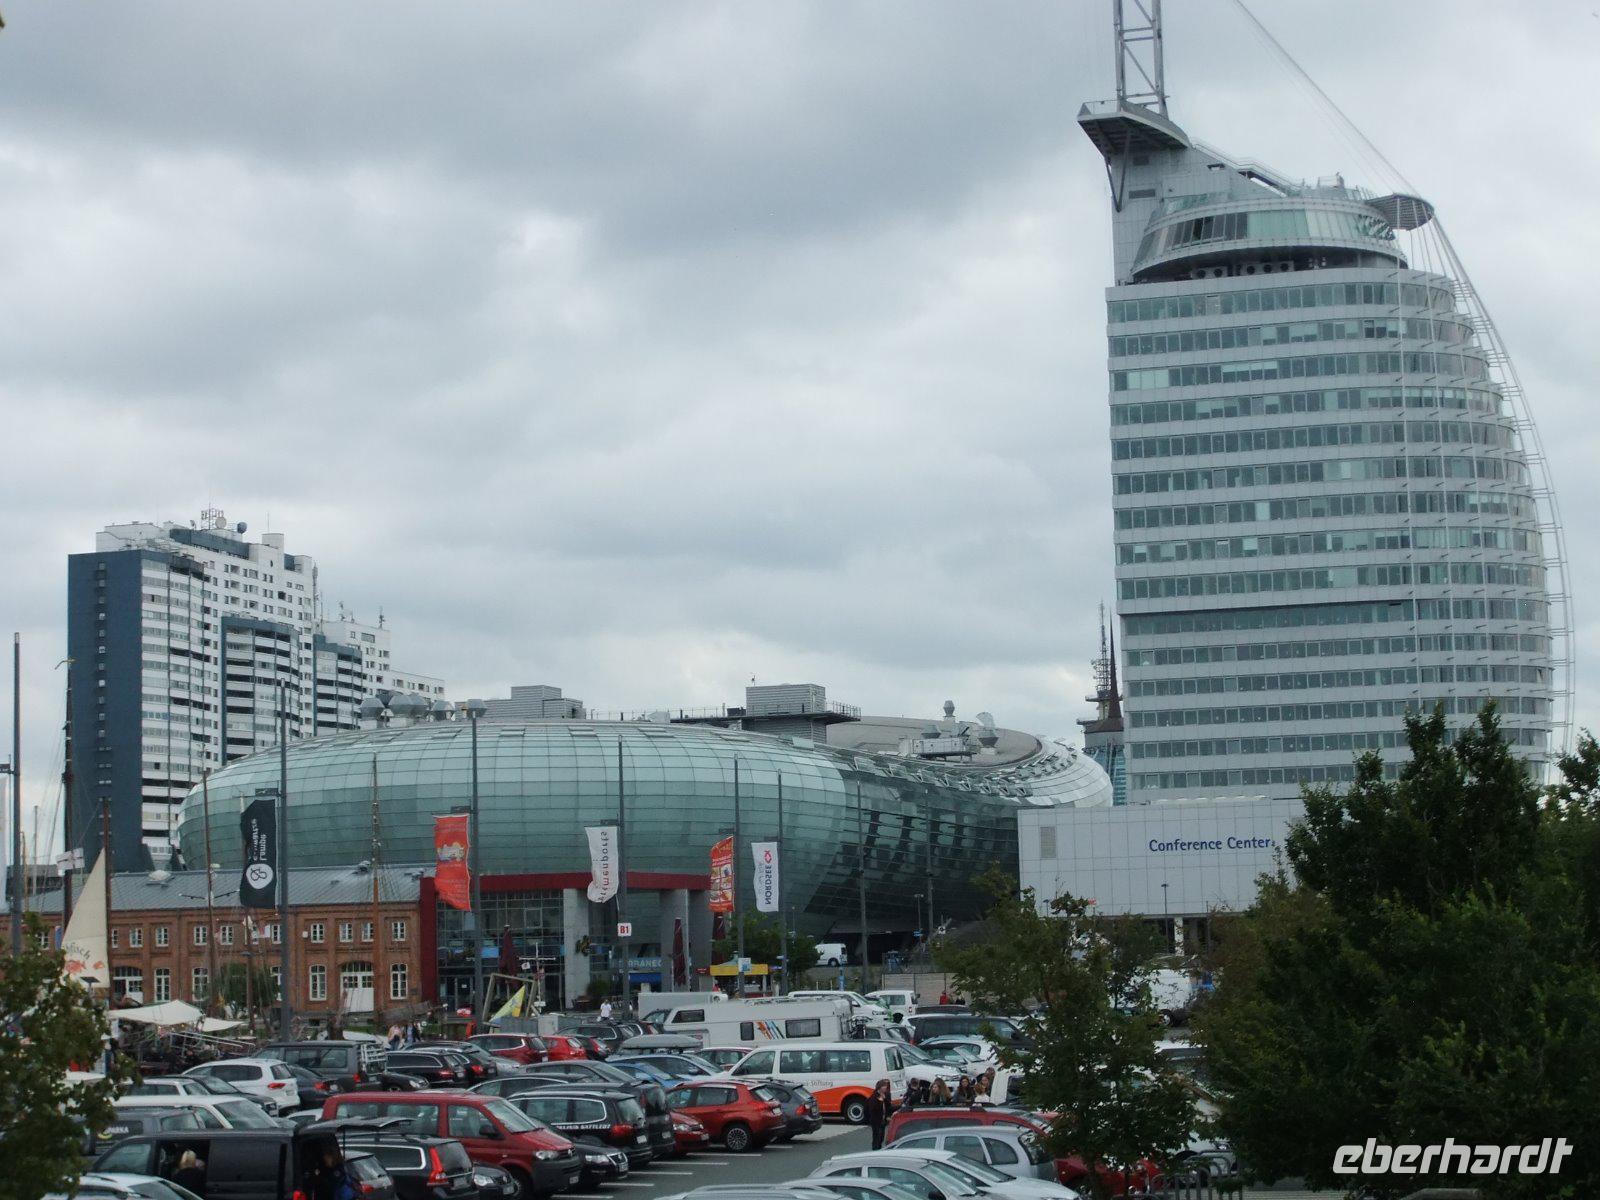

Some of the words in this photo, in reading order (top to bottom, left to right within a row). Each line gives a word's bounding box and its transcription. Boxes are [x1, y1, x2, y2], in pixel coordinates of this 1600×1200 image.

[1149, 839, 1222, 852] Conference
[1227, 836, 1270, 849] Center
[619, 925, 630, 935] B1
